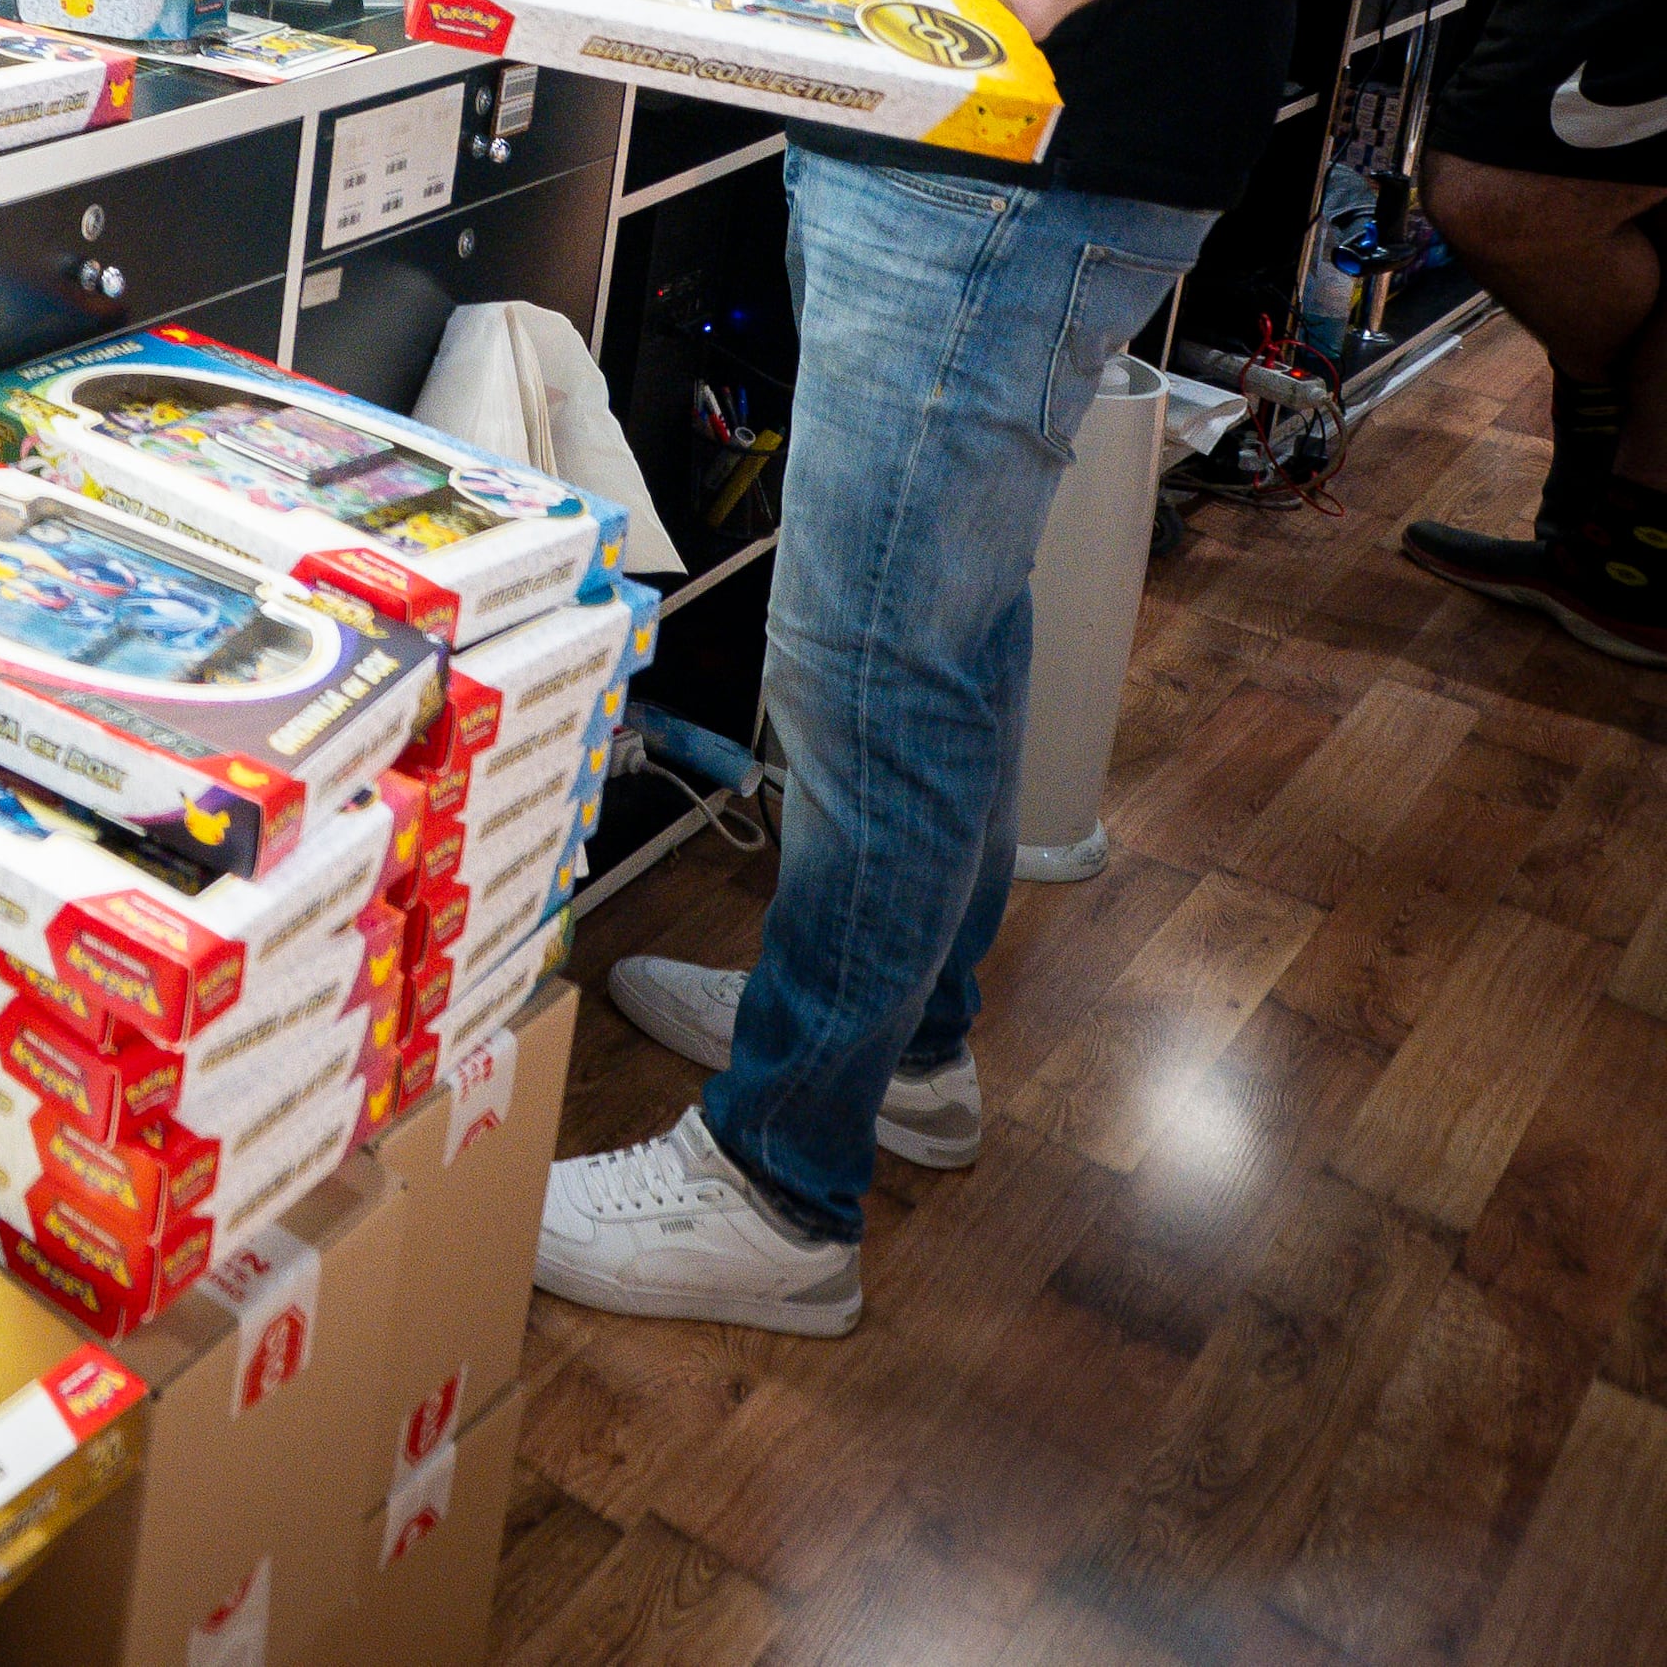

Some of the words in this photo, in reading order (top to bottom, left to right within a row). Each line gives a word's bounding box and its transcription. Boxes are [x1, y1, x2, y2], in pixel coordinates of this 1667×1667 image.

[427, 1, 502, 32] Pokémon
[580, 35, 700, 77] BINDER
[694, 58, 886, 113] COLLECTION
[24, 731, 61, 762] ex
[64, 744, 130, 794] BOX
[67, 942, 164, 1019] Pokémon
